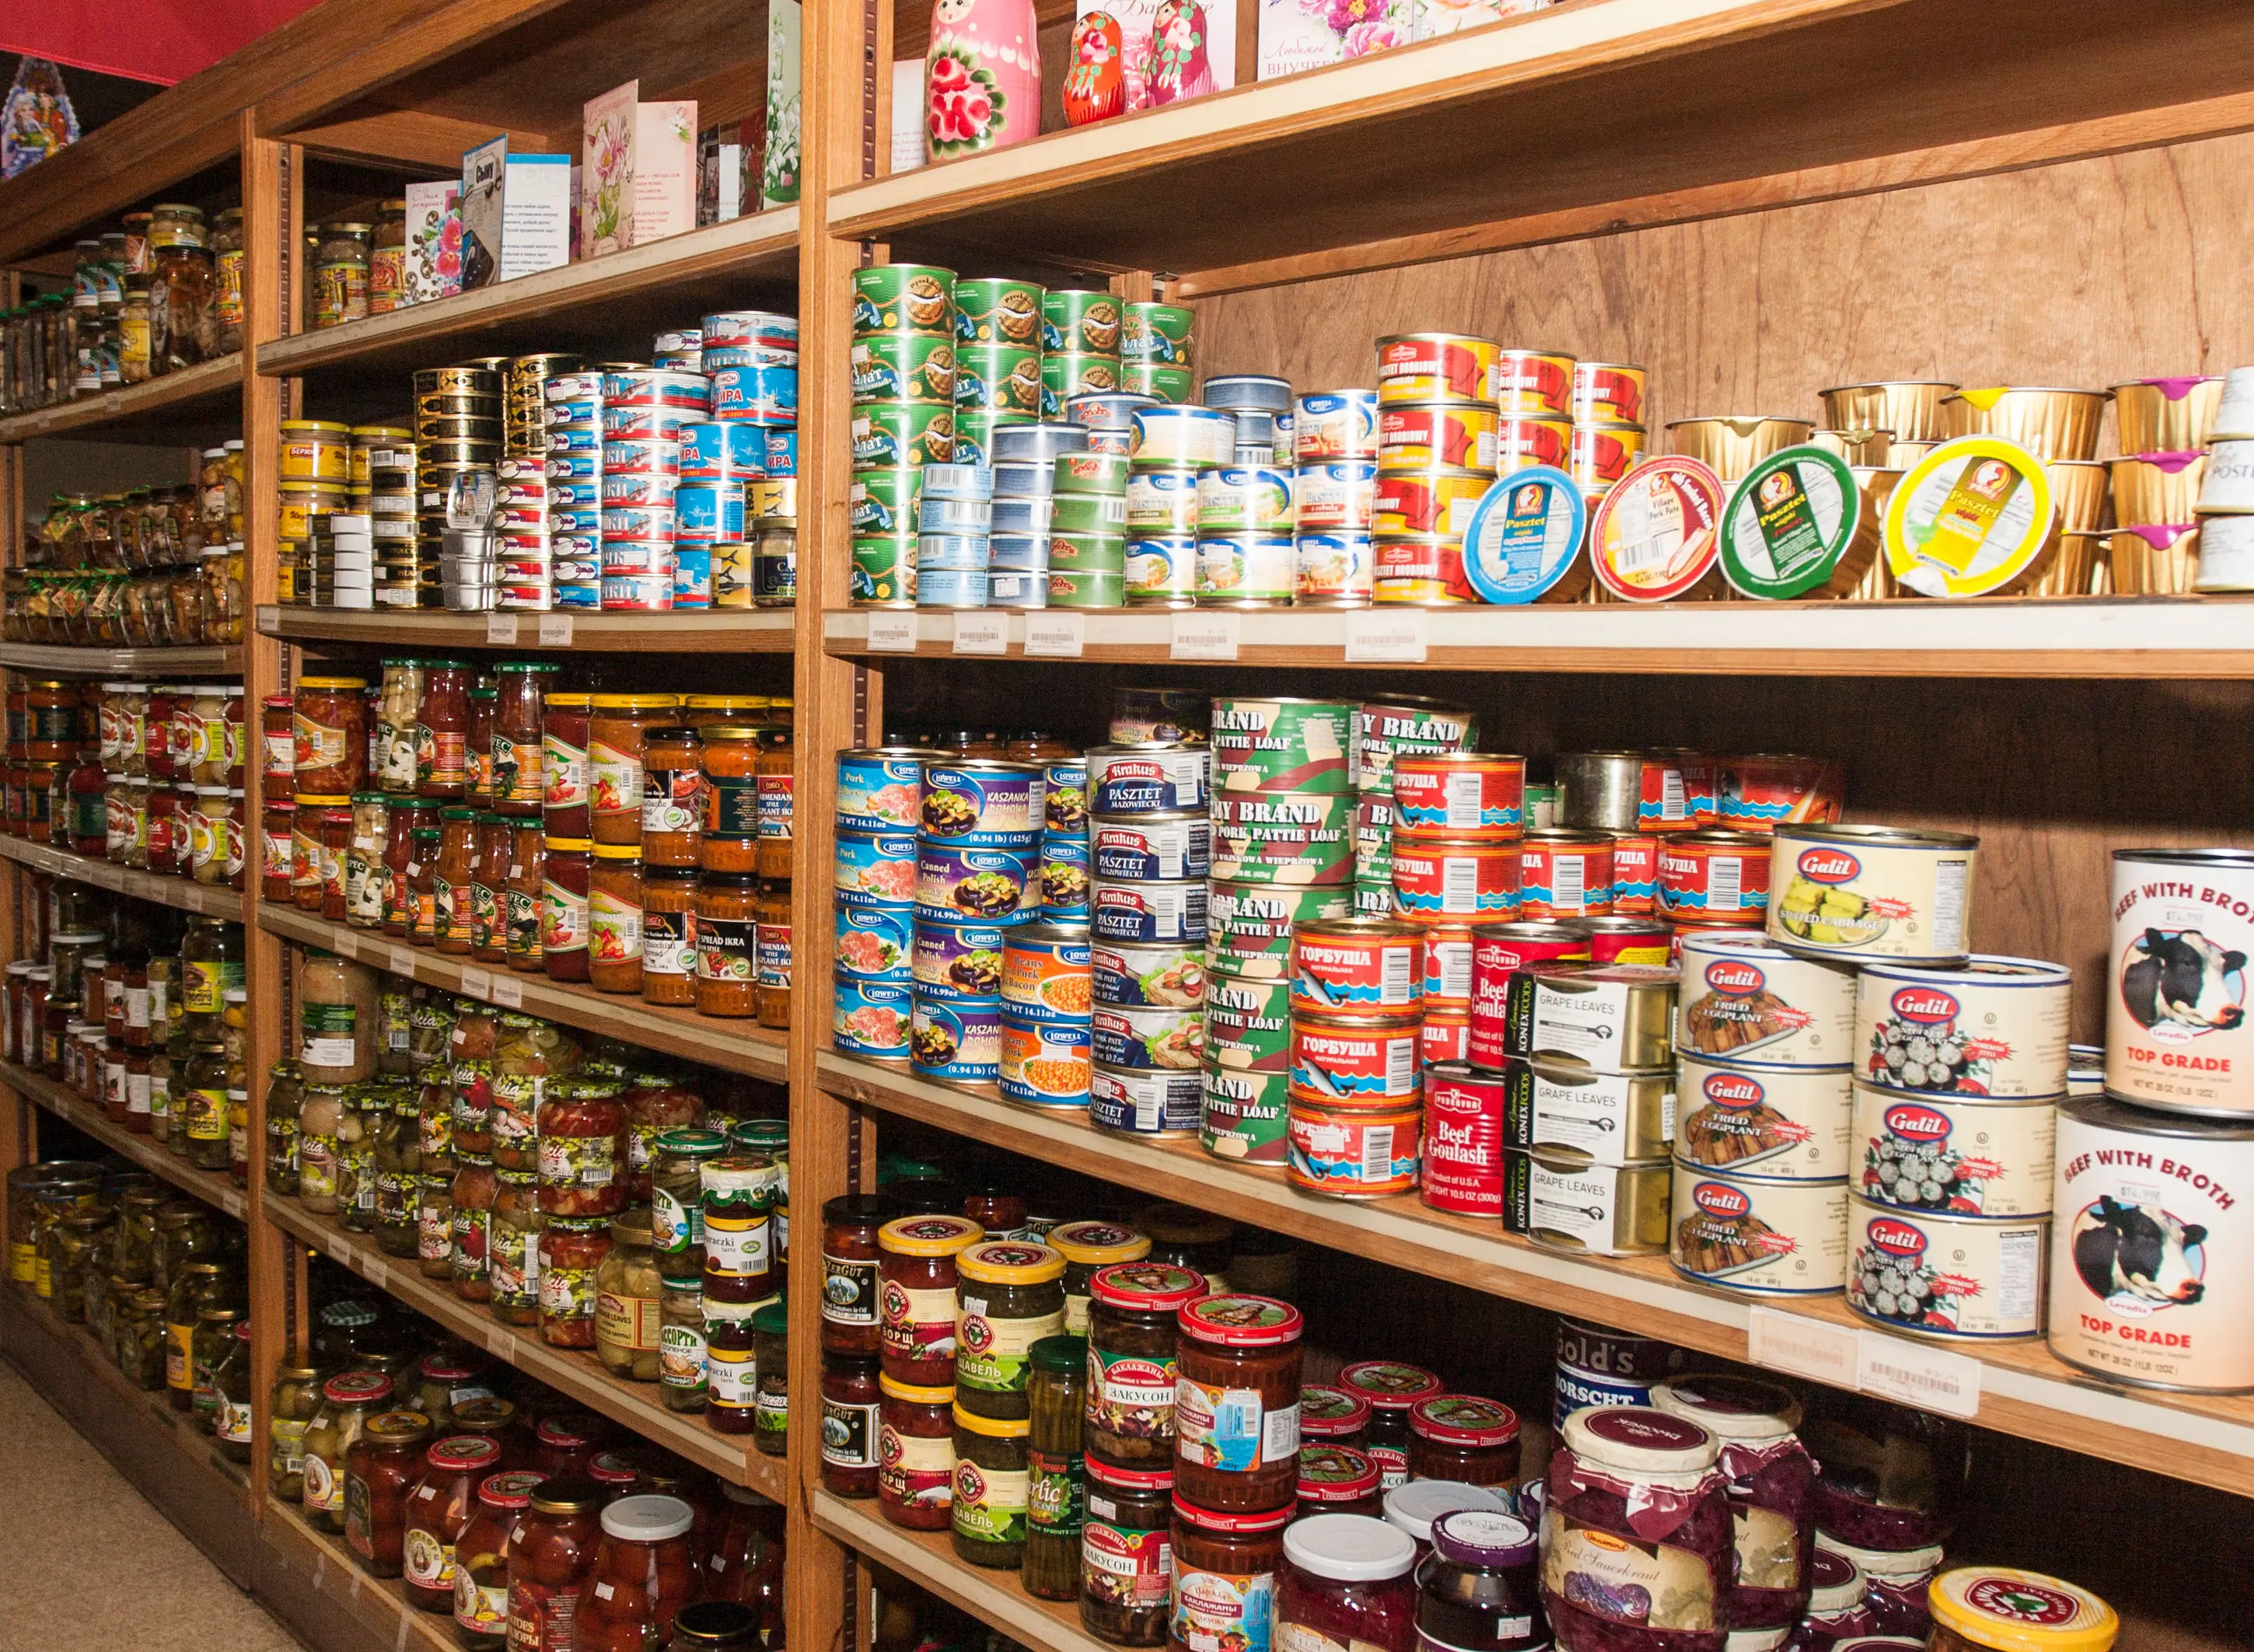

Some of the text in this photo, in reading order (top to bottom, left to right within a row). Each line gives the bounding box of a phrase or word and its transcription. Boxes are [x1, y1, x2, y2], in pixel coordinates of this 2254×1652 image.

[1653, 498, 1674, 509] Village
[1760, 493, 1807, 527] Pasztet
[1950, 489, 2000, 518] Pasztet
[1505, 518, 1546, 529] Pasztet
[1382, 715, 1460, 742] BRAND
[1255, 737, 1291, 750] LOAF
[1111, 763, 1156, 777] Krakus
[845, 773, 865, 784] Pork
[934, 774, 961, 783] LOWELL
[1110, 788, 1162, 800] PASZTET
[1110, 799, 1160, 808] MAZOWIECKI
[1238, 802, 1321, 824] BRAND
[844, 817, 886, 828] WT 14.11oz
[969, 833, 1031, 843] (0.94 lb) (425g)
[1101, 832, 1141, 847] Krakus
[1251, 829, 1305, 842] PATTIE
[1311, 829, 1341, 842] LOAF
[1050, 847, 1077, 856] LOWELL
[977, 856, 1006, 864] LOWELL
[1099, 856, 1146, 871] PASZTET
[1801, 856, 1853, 877] Galil
[921, 861, 950, 874] Canned
[1100, 868, 1143, 878] MAZOWIECKI
[923, 875, 946, 885] Polish
[850, 893, 877, 904] 14.11oz
[1099, 891, 1137, 905] Krakus
[2115, 882, 2193, 923] BEEF WITH
[856, 913, 882, 922] LOWELL
[934, 910, 963, 920] 14.99oz
[1098, 914, 1142, 929] PASZTET
[1224, 920, 1271, 938] PATTIE
[1822, 917, 1880, 931] CABBAGE
[1099, 927, 1140, 938] MAZOWIECKI
[701, 935, 745, 947] SPREAD IKRA
[917, 938, 945, 951] Canned
[918, 950, 942, 962] Polish
[1014, 955, 1043, 969] Beans
[1300, 945, 1372, 966] ГОРБУША
[1710, 969, 1759, 990] Galil
[871, 989, 900, 998] LOWELL
[930, 986, 958, 997] 14.99oz
[1539, 994, 1615, 1015] GRAPE LEAVES
[1896, 996, 1952, 1015] Galil
[1025, 1007, 1057, 1018] 14.11oz
[1247, 1016, 1284, 1031] LOAF
[1050, 1032, 1082, 1040] LOWELL
[1302, 1036, 1378, 1057] ГОРБУША
[2126, 1047, 2231, 1073] TOP GRADE
[1010, 1087, 1037, 1098] 14.11oz
[1539, 1087, 1616, 1107] GRAPE LEAVES
[1707, 1081, 1759, 1101] Galil
[1242, 1105, 1280, 1119] LOAF
[1712, 1113, 1749, 1126] FRIED
[1889, 1112, 1945, 1134] Galil
[1438, 1121, 1473, 1144] Beef
[1428, 1137, 1487, 1165] Goulash
[1534, 1172, 1605, 1196] GRAPE LEAVES
[2064, 1150, 2236, 1211] BEEF WITH BROTH
[1477, 1192, 1501, 1203] (300g)
[1697, 1190, 1744, 1211] Galil
[1871, 1225, 1920, 1249] Galil
[2080, 1314, 2193, 1349] TOP GRADE
[958, 1358, 1001, 1378] ЩАВЕЛЬ
[1109, 1387, 1169, 1405] ЗАКУСОН
[1560, 1540, 1662, 1582] Red Sauerkraut
